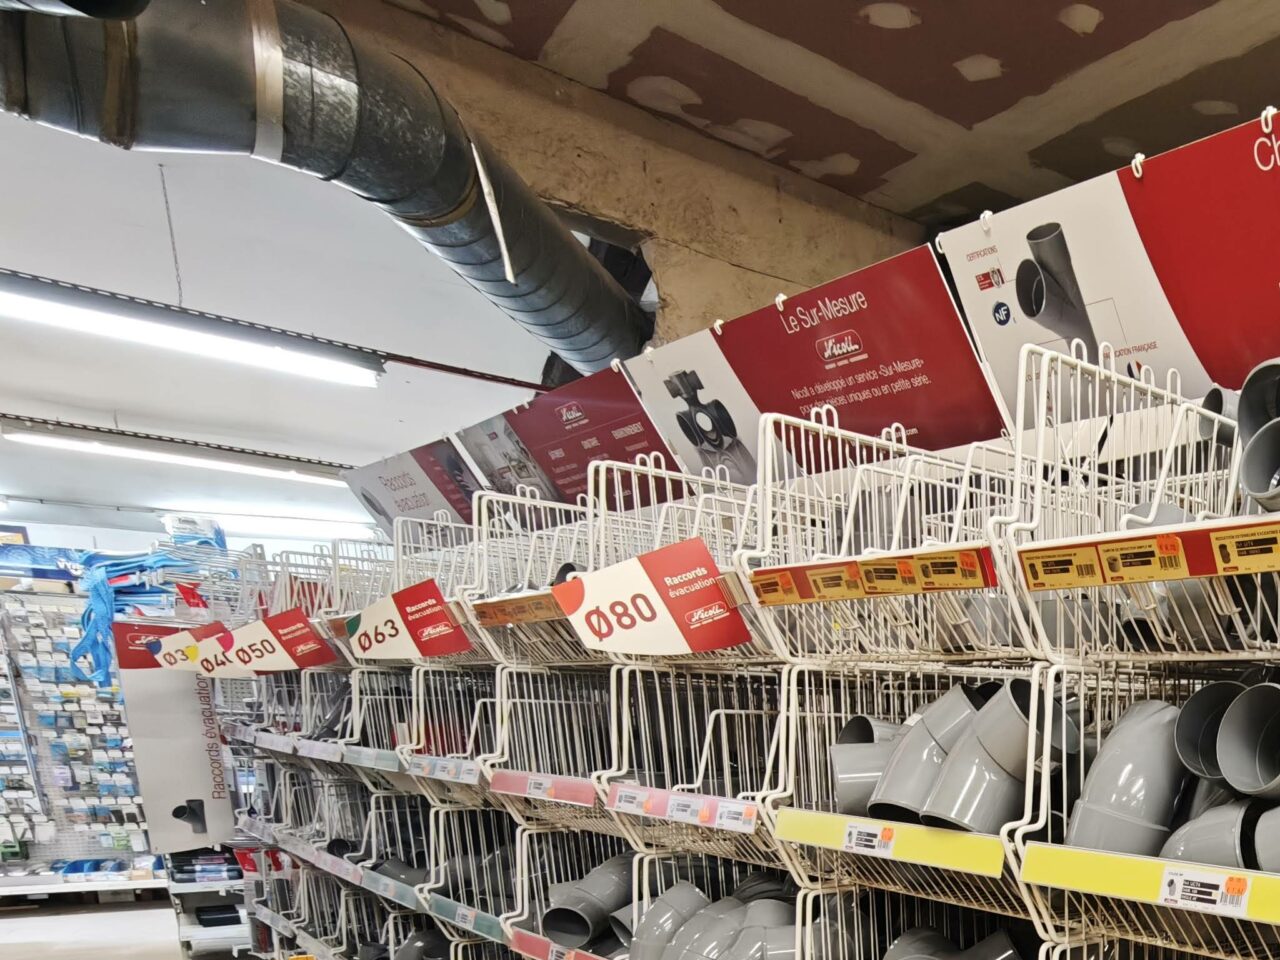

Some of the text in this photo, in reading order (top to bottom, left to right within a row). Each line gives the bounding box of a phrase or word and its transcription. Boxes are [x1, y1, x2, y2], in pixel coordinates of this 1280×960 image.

[779, 291, 868, 334] Le Sur-Mesure
[663, 566, 708, 587] Raccords
[668, 576, 716, 599] évacuation
[584, 593, 657, 642] Ø80
[690, 604, 724, 622] Nicoll
[358, 619, 399, 653] Ø63
[162, 648, 189, 666] Ø3
[235, 639, 276, 665] Ø50
[197, 673, 227, 800] Raccords évacuation
